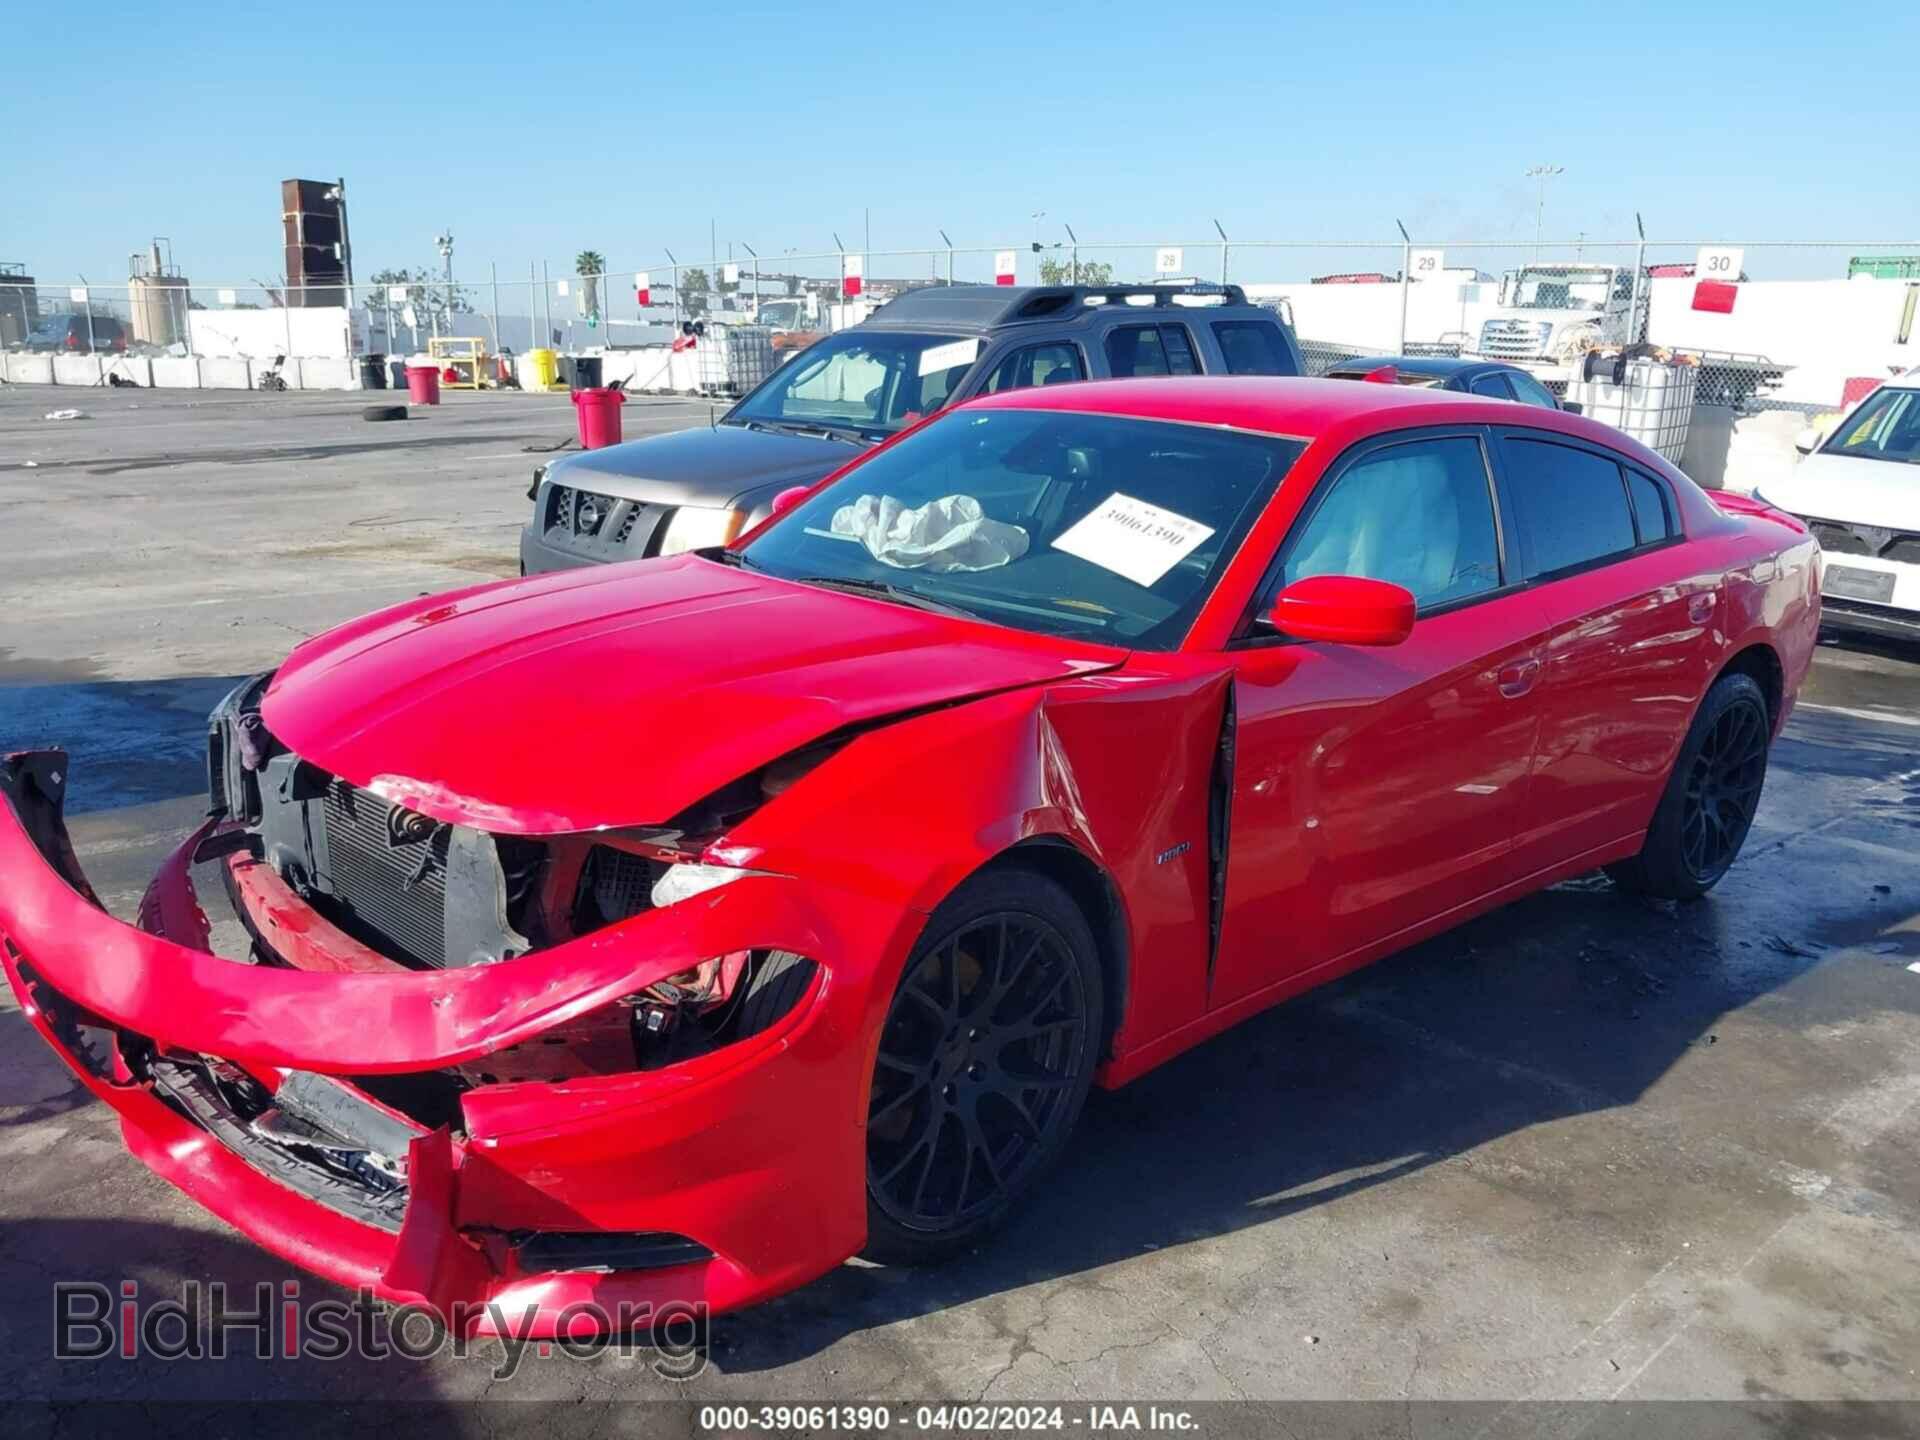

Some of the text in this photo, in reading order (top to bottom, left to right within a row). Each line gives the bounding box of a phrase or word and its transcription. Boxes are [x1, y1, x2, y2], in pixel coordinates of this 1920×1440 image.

[1162, 255, 1176, 266] 28
[1419, 257, 1435, 270] 29
[1708, 256, 1730, 271] 30
